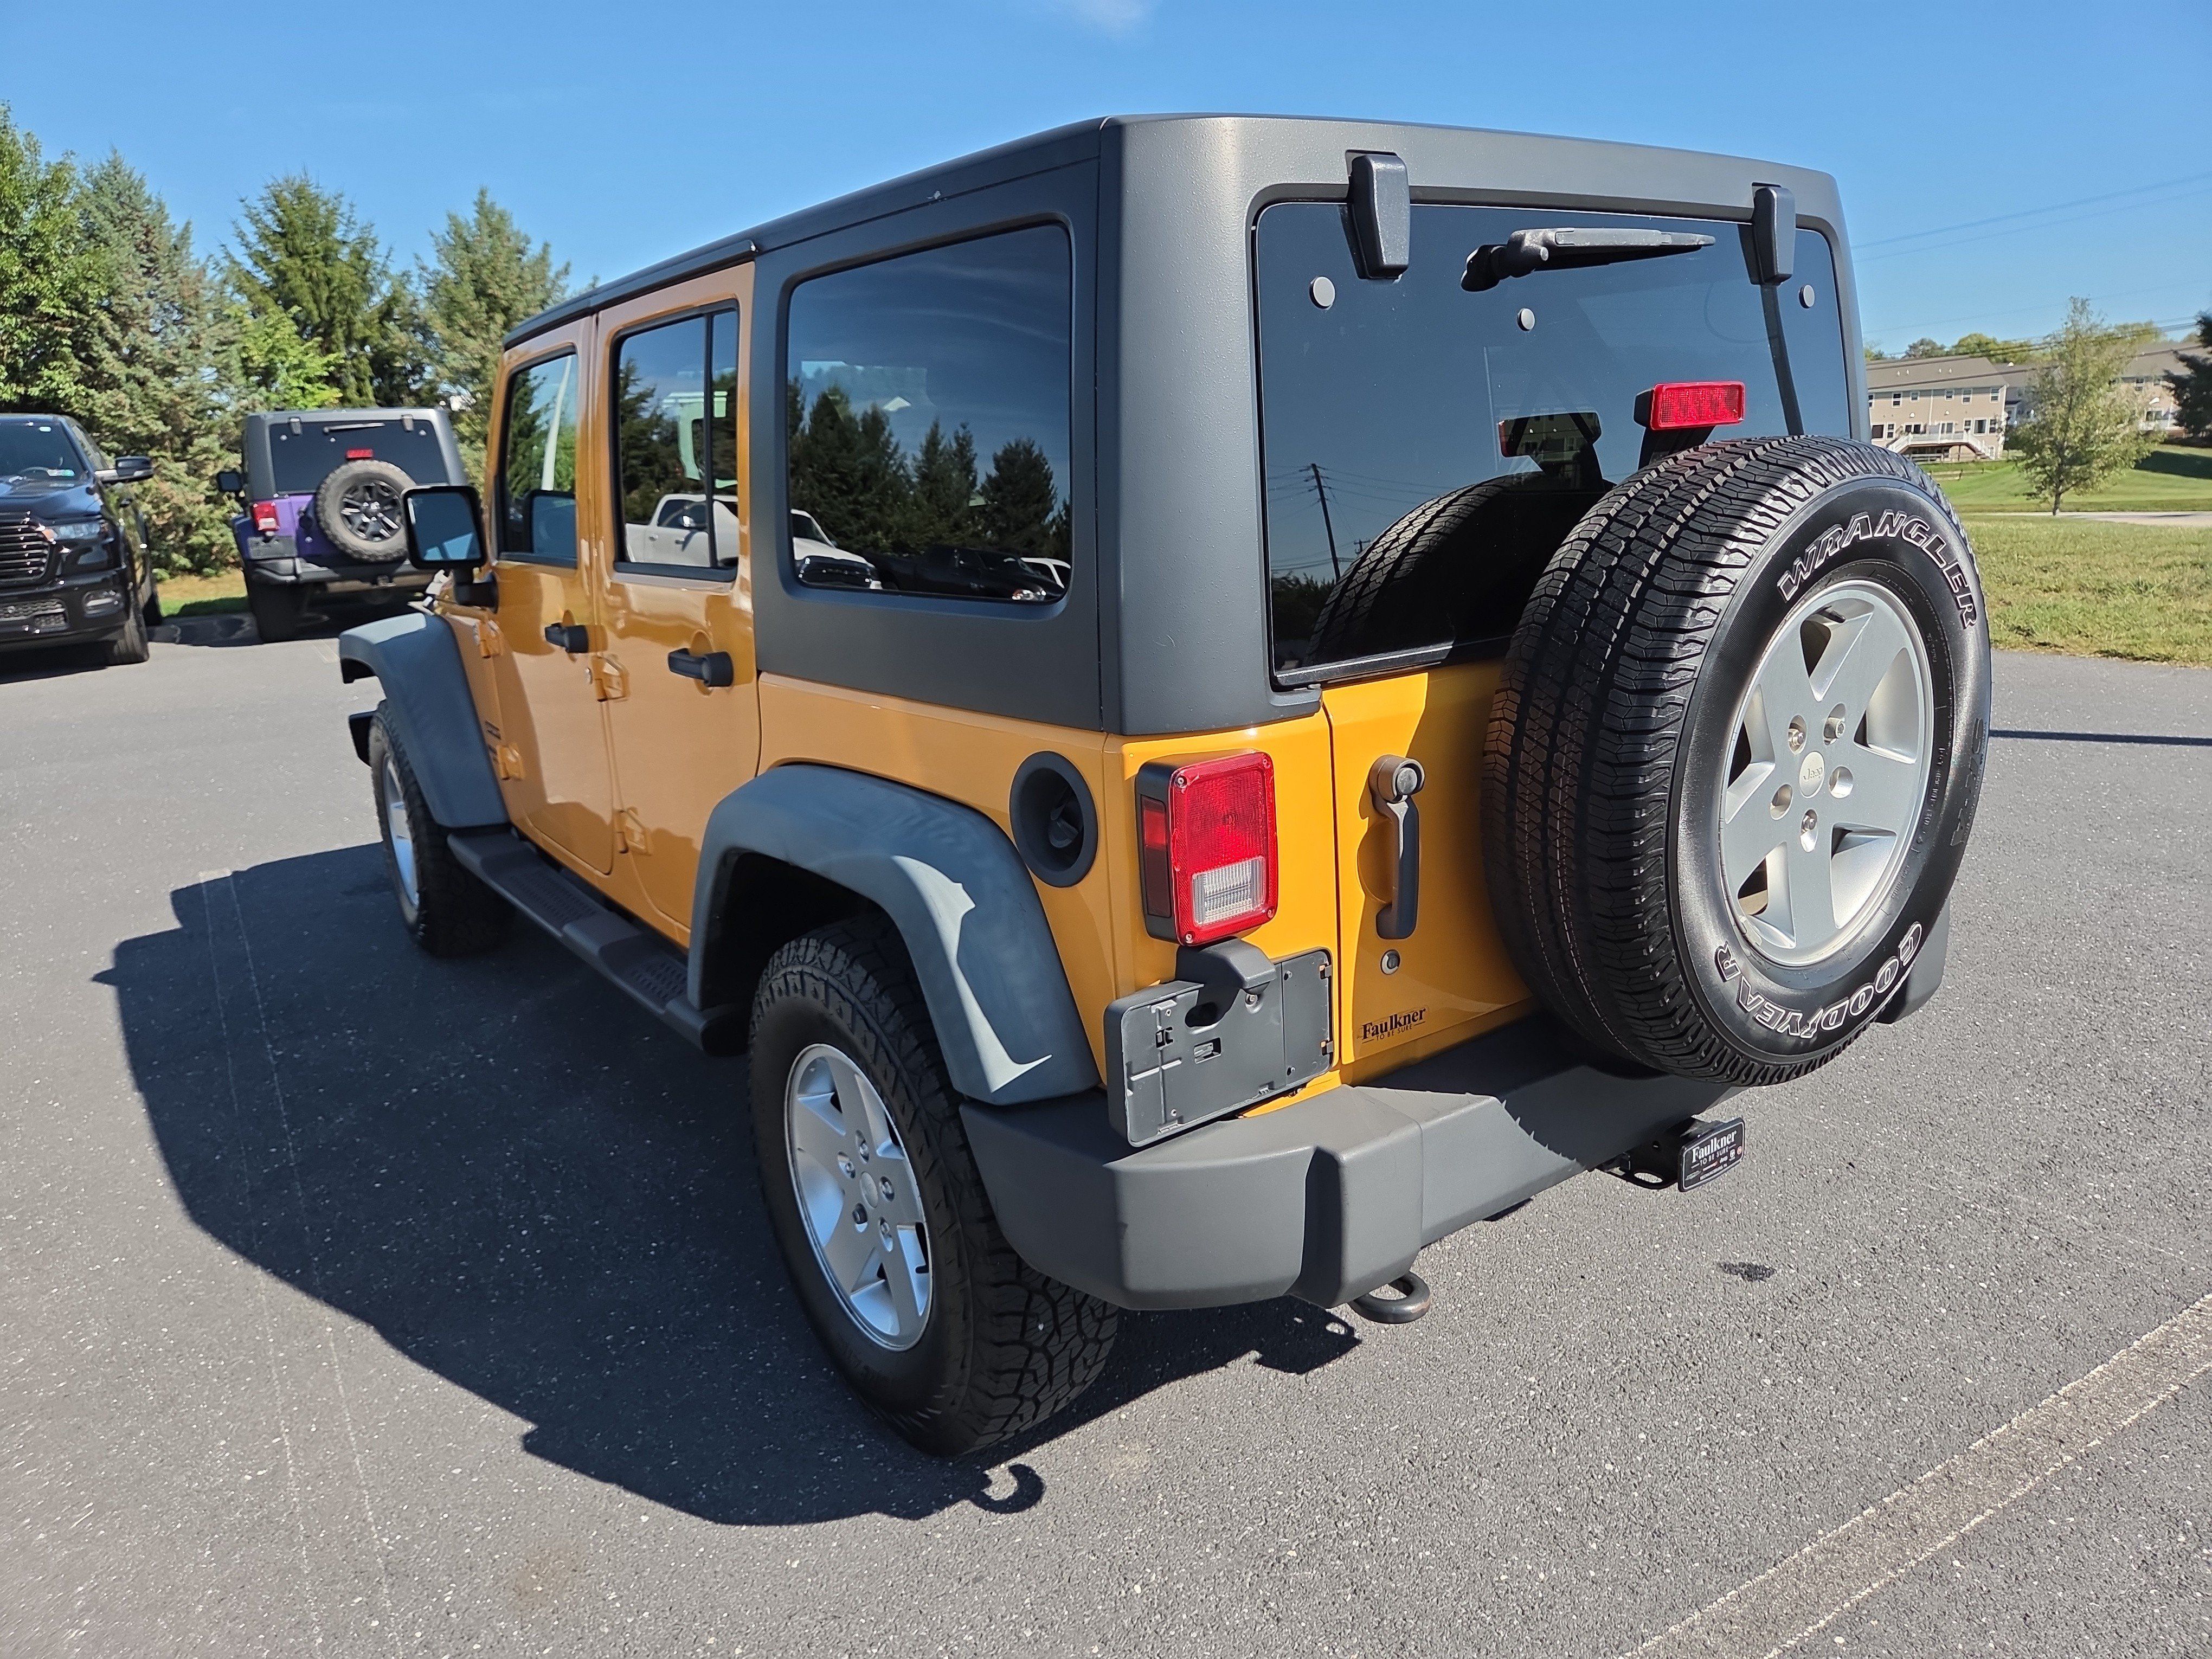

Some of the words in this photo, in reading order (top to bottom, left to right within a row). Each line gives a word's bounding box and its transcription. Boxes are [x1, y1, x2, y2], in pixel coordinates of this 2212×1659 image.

[1777, 509, 1978, 631] WRANGLER
[1803, 766, 1823, 781] Jeep
[1715, 921, 1922, 1038] GOODYEAR
[1362, 1008, 1426, 1040] Faulkner
[1397, 1024, 1412, 1034] SURE
[1692, 1130, 1737, 1163] Faulkner
[1700, 1158, 1707, 1166] TO
